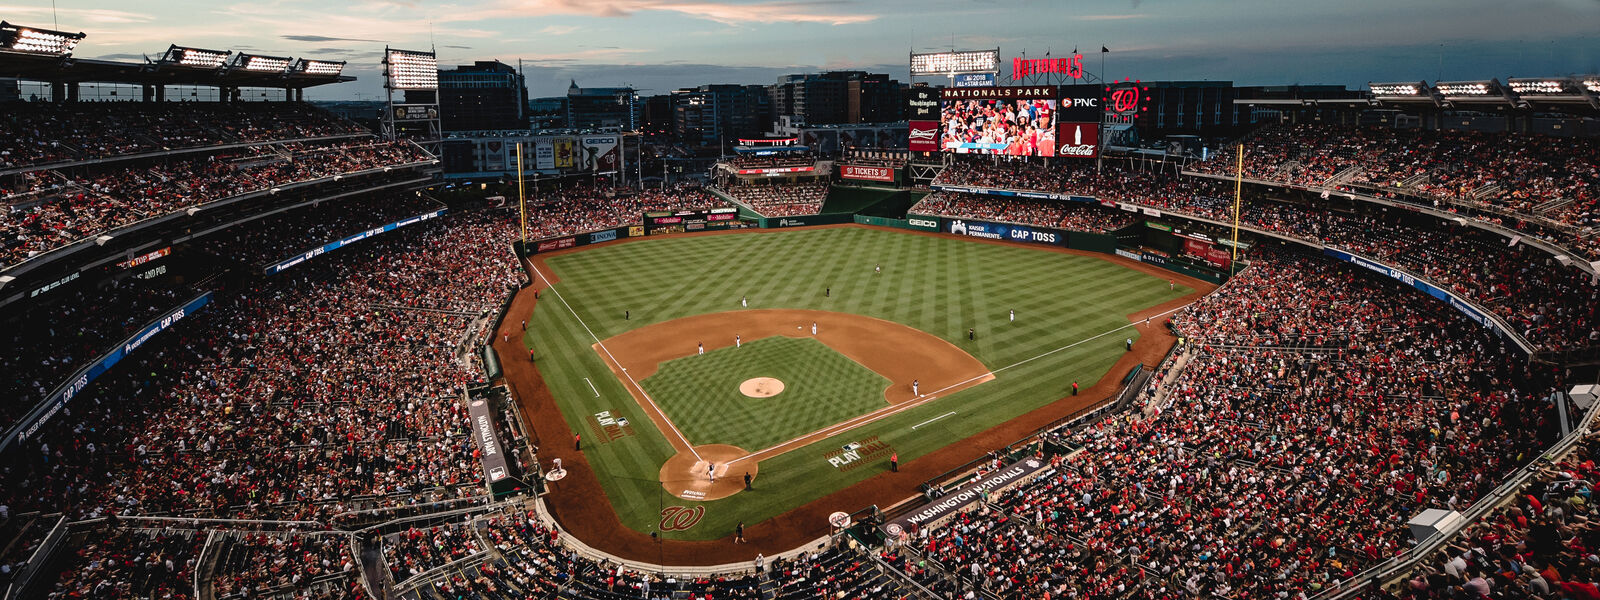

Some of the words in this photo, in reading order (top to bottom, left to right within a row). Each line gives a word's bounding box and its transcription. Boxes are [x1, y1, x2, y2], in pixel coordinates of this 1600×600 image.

[1013, 54, 1083, 80] NATIONALS
[1074, 98, 1097, 107] PNC
[854, 168, 879, 176] TICKETS
[909, 219, 936, 228] GEICO
[596, 231, 616, 240] INOVA
[1011, 230, 1029, 239] CAP
[1032, 232, 1055, 242] TOSS
[305, 250, 314, 260] CAP
[1148, 256, 1164, 264] DELTA
[1390, 270, 1401, 279] CAP
[1402, 274, 1414, 286] TOSS
[161, 317, 171, 329] CAP
[172, 309, 185, 322] TOSS
[1484, 317, 1493, 329] CAP
[63, 386, 74, 403] CAP
[74, 374, 88, 392] TOSS
[595, 411, 616, 426] PLAY
[478, 415, 492, 442] NATIONALS
[484, 440, 496, 456] PARK
[828, 450, 861, 468] PLAY
[858, 440, 890, 456] BALL
[907, 489, 976, 524] WASHINGTON
